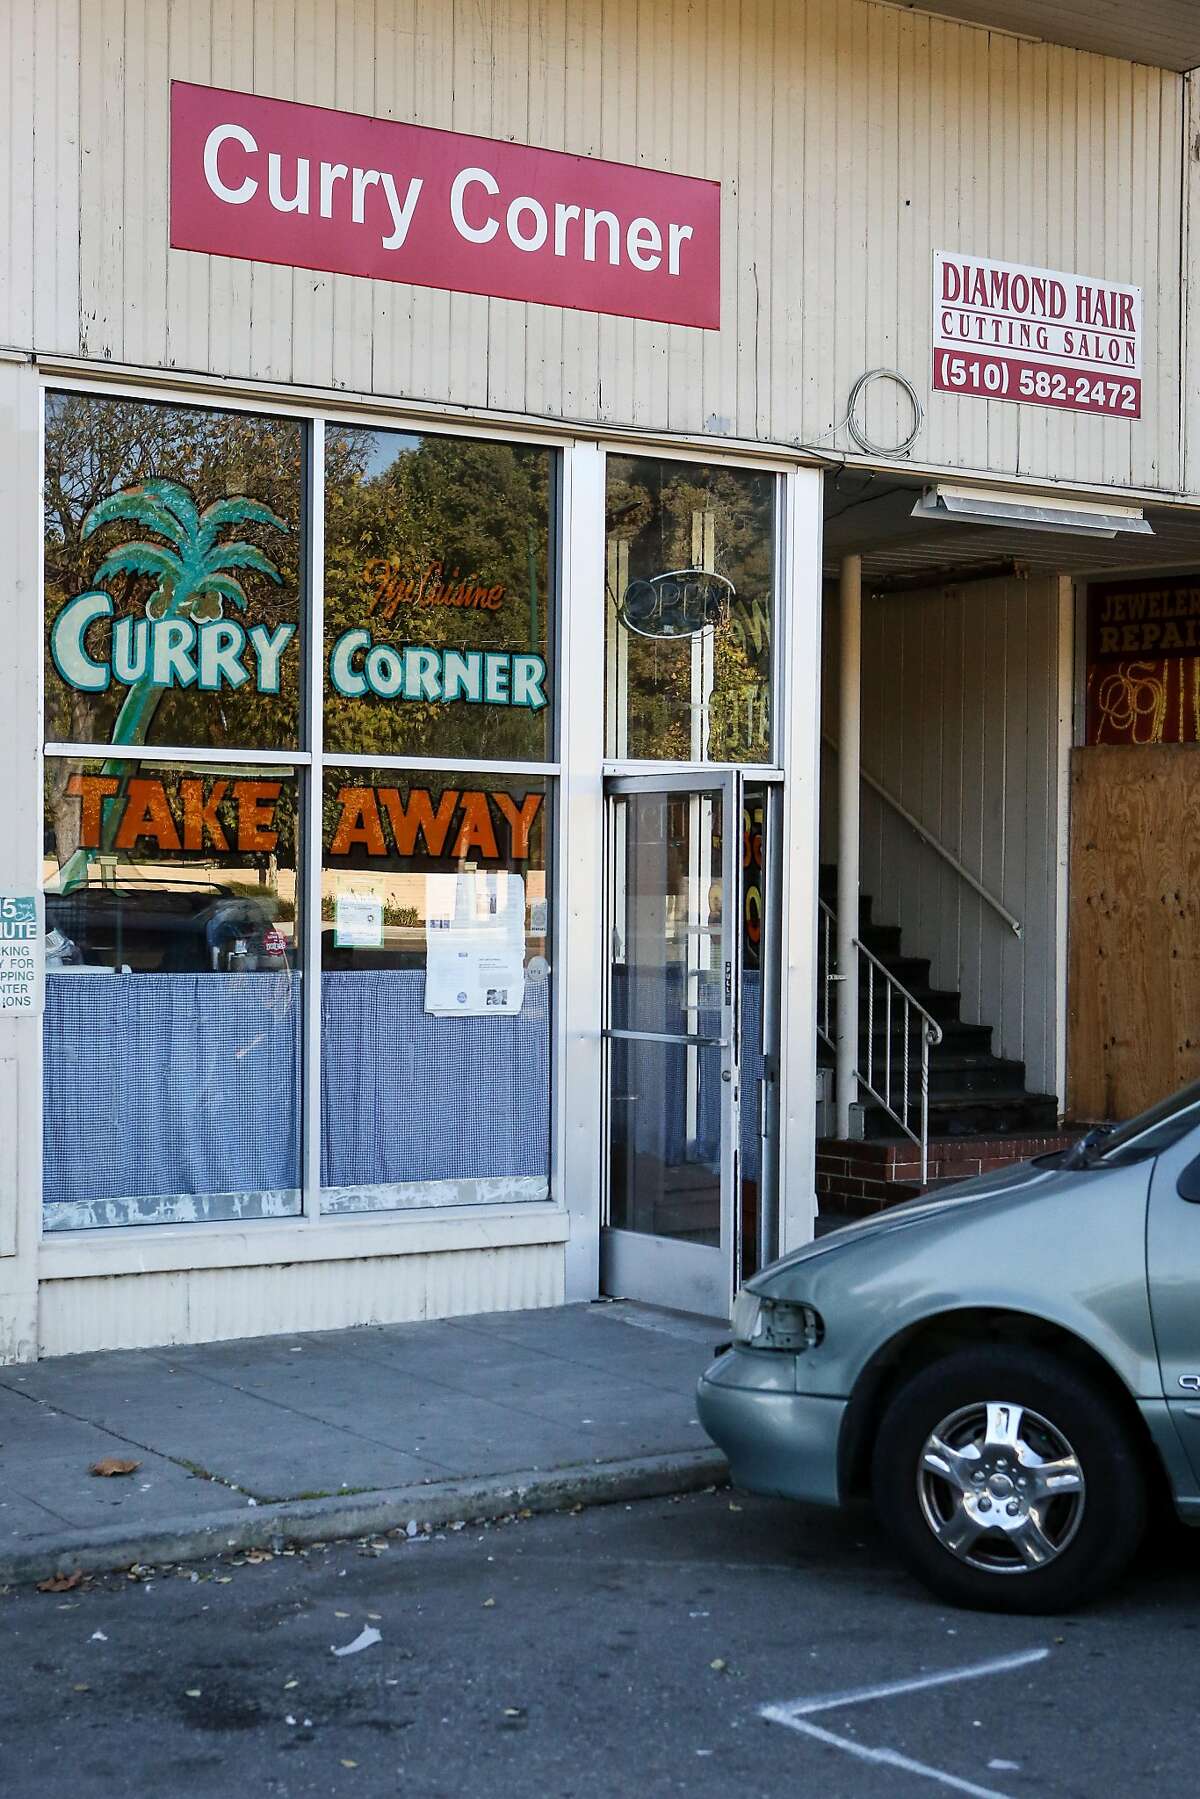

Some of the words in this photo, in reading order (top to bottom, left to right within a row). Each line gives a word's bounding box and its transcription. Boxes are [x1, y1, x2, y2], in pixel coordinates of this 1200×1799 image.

[202, 123, 423, 250] Curry
[449, 166, 693, 276] Corner
[941, 261, 1067, 319] DIAMOND
[1075, 285, 1136, 333] HAIR
[941, 311, 1049, 350] CUTTING
[1064, 330, 1136, 365] SALON
[941, 353, 1009, 394] (510)
[1019, 368, 1136, 411] 582-2472
[50, 590, 298, 695] CURRY
[329, 627, 549, 711] CORNER
[1099, 618, 1200, 654] REPAI
[65, 773, 284, 853] TAKE
[329, 785, 545, 861] AWAY
[0, 898, 17, 918] 5
[0, 946, 30, 956] KING
[10, 959, 34, 968] FOR
[3, 996, 31, 1006] ONS
